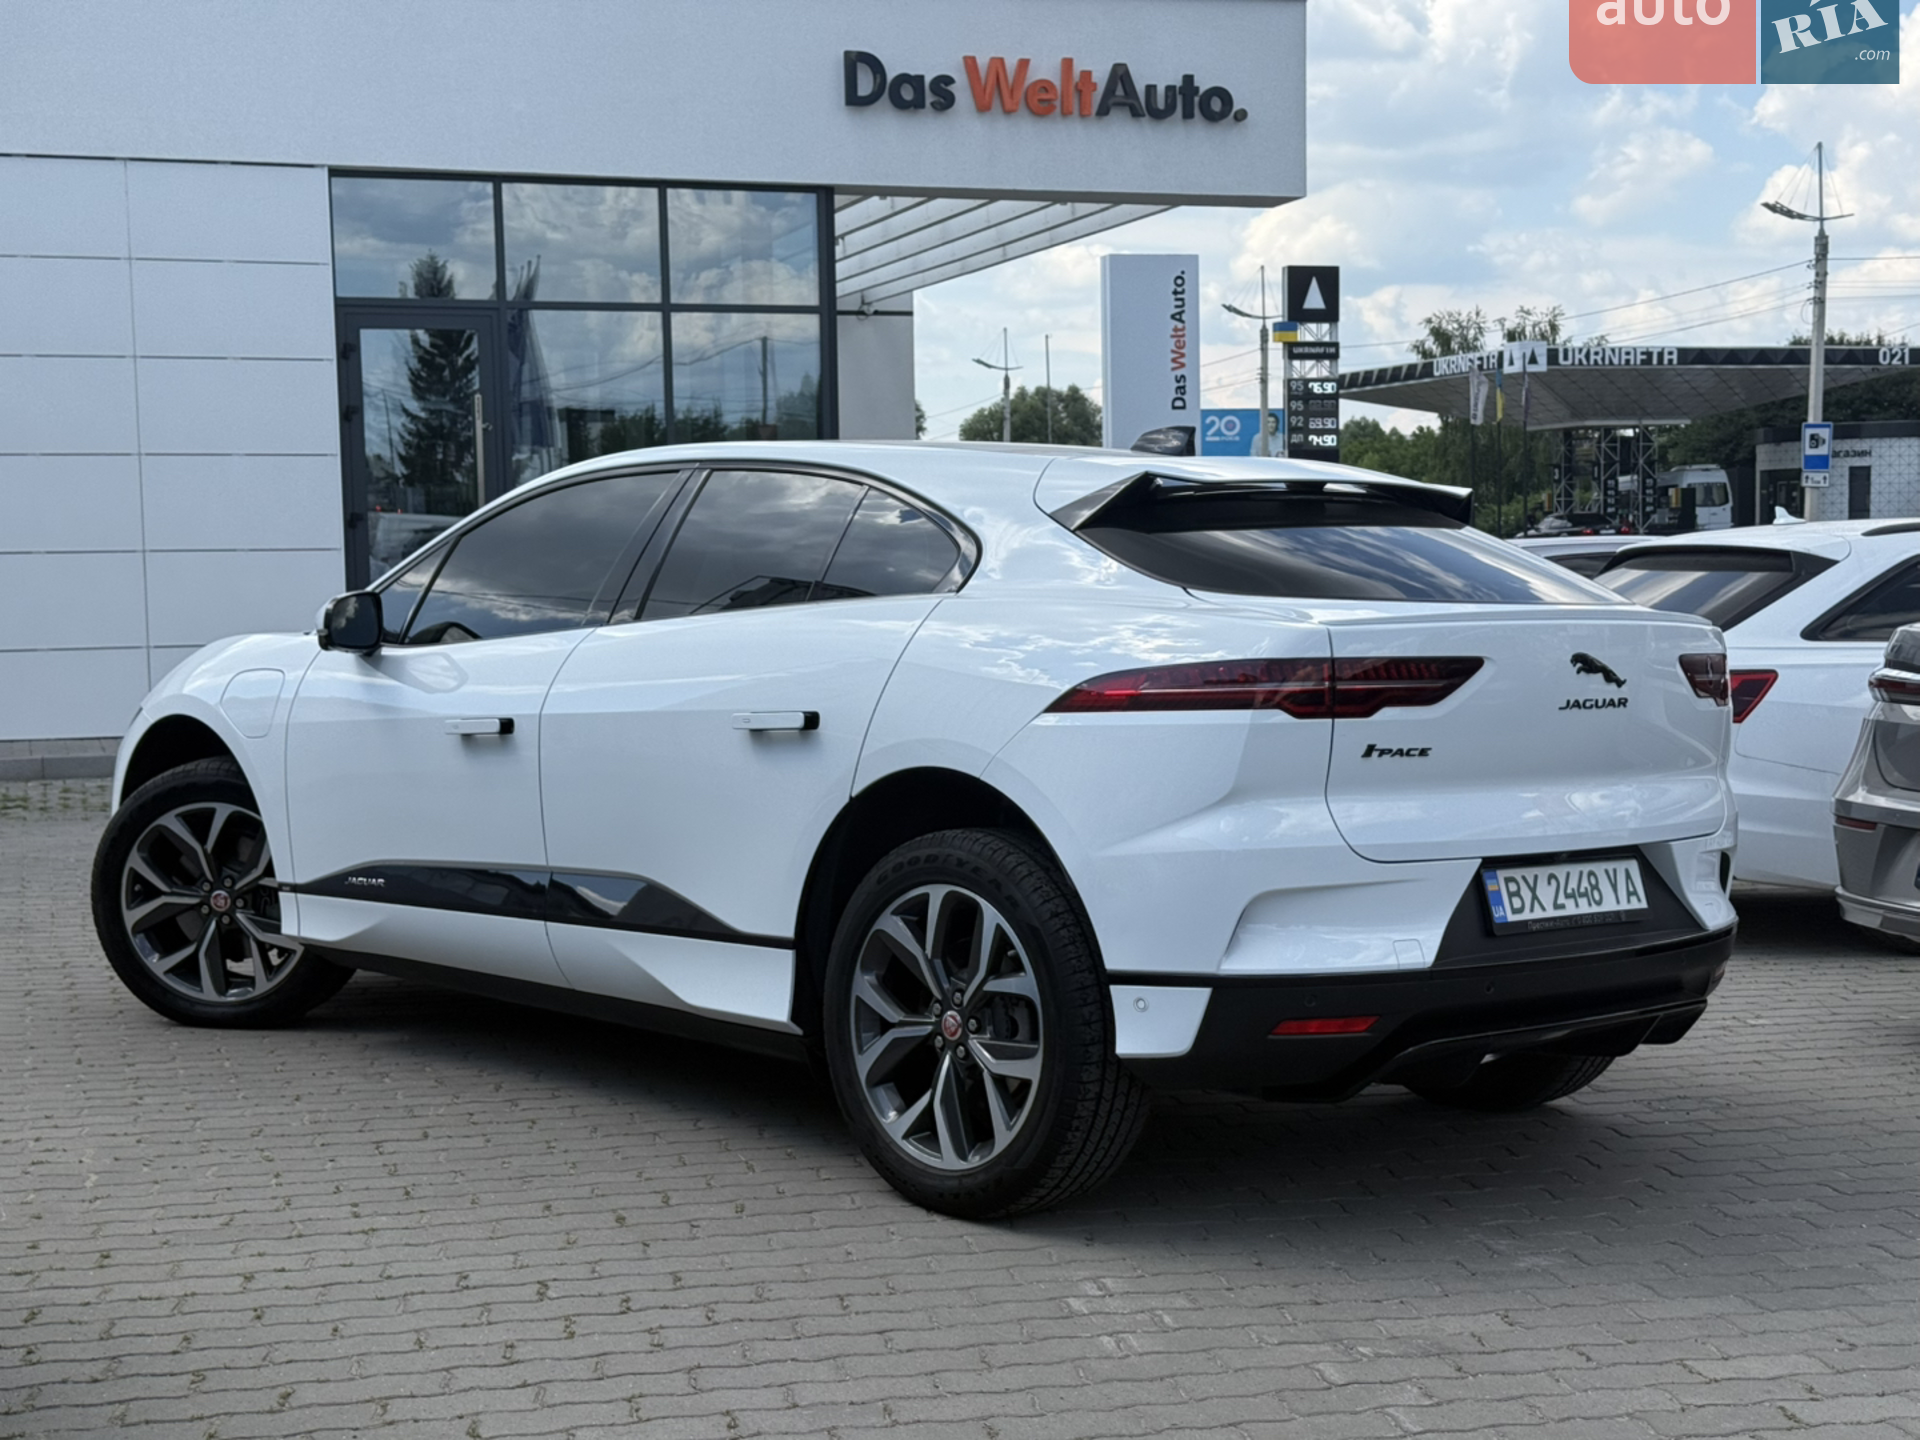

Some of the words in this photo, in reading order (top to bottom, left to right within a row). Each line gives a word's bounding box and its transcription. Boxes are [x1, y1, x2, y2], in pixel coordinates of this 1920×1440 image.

[843, 50, 956, 111] Das
[1558, 347, 1678, 365] UKRNAFTA
[1879, 347, 1909, 365] 021
[1171, 374, 1187, 410] Das
[1290, 381, 1304, 391] 95
[1308, 382, 1337, 394] 76.90
[1290, 401, 1304, 411] 95
[1205, 415, 1241, 436] 20
[1290, 416, 1304, 427] 92
[1308, 435, 1337, 446] 74.90
[1832, 448, 1872, 458] агазин
[1558, 697, 1629, 710] JAGUAR
[344, 876, 386, 888] JAGUAR
[1503, 873, 1547, 915] BX
[1547, 869, 1603, 911] 2448
[1604, 867, 1642, 905] YA
[1492, 905, 1505, 918] UA
